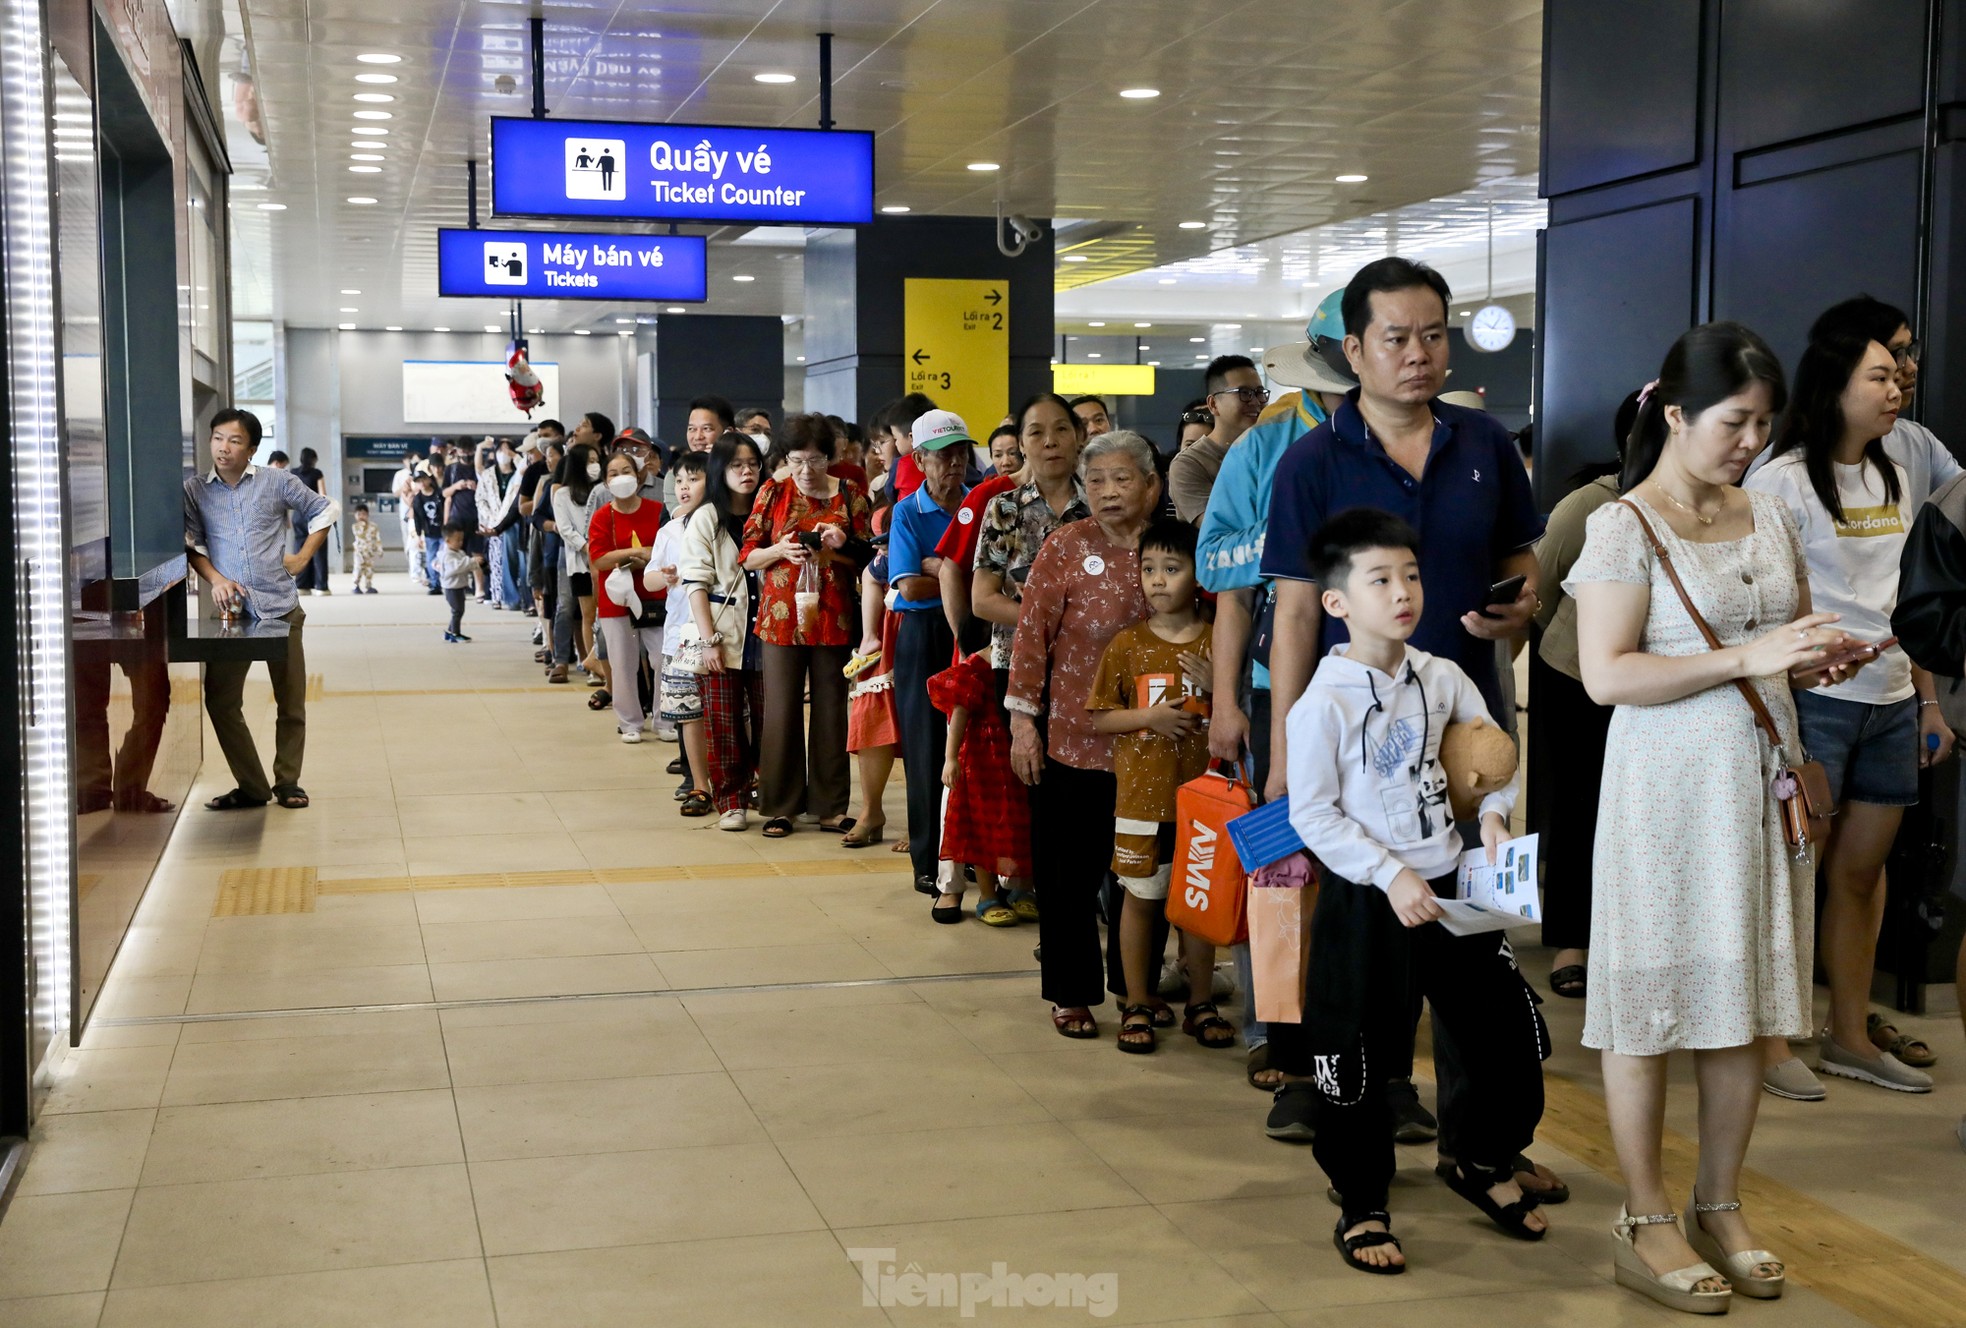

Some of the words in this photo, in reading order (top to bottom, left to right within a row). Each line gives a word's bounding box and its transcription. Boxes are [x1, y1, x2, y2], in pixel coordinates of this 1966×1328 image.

[649, 139, 729, 179] Quầy
[735, 144, 772, 174] vé
[650, 181, 715, 204] Ticket
[720, 183, 806, 207] Counter
[543, 243, 586, 271] Máy
[592, 244, 633, 267] bán
[637, 246, 664, 268] vé
[544, 271, 599, 288] Tickets
[980, 313, 990, 321] ra
[992, 312, 1003, 331] 2
[928, 372, 938, 381] ra
[940, 372, 951, 390] 3
